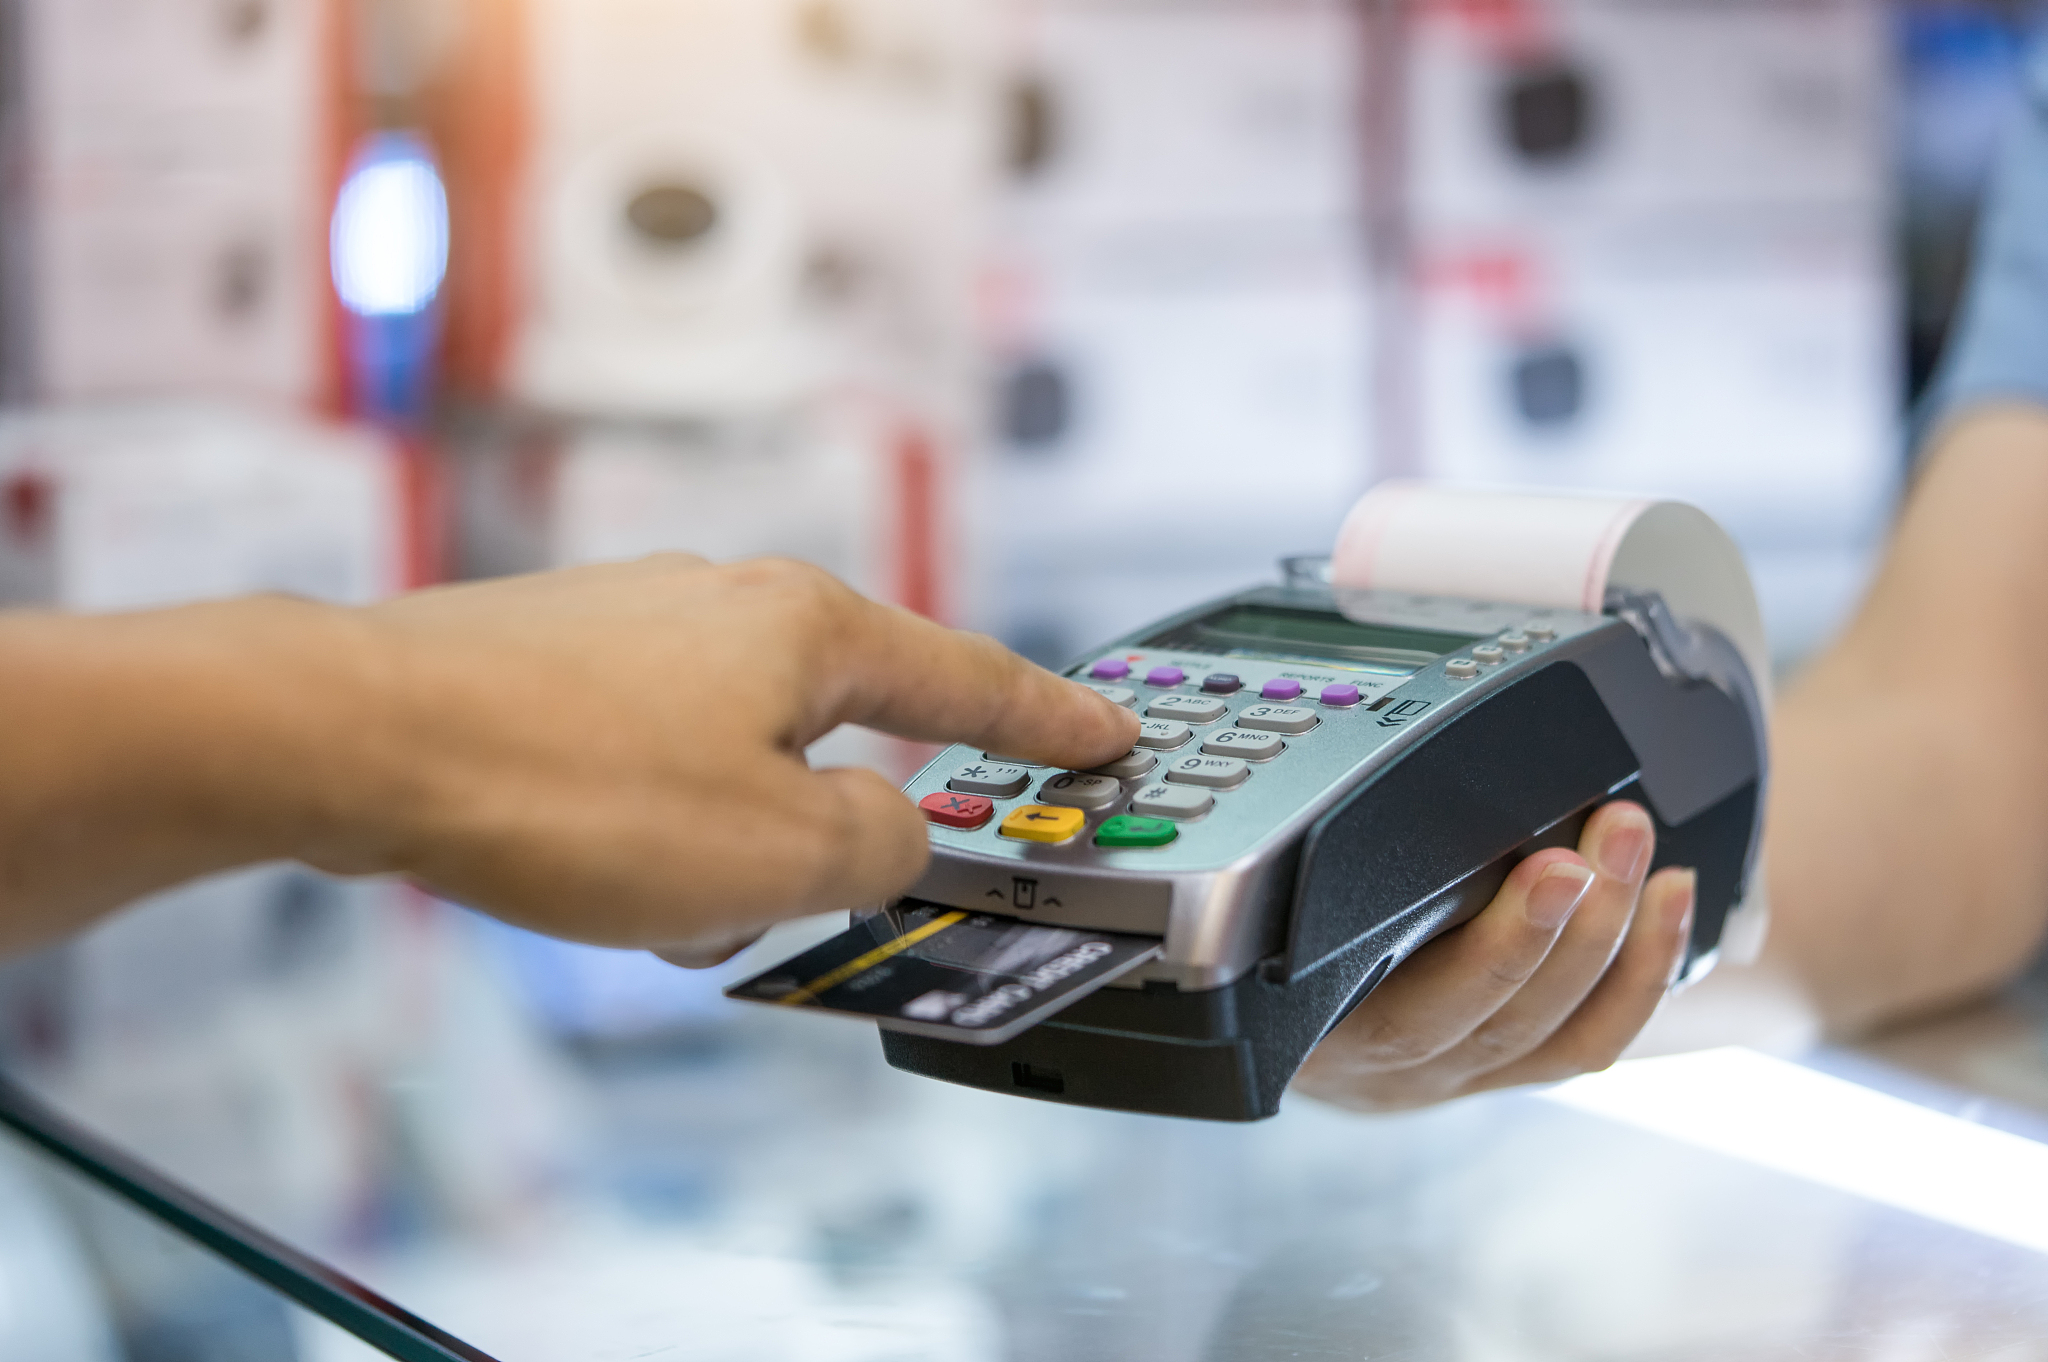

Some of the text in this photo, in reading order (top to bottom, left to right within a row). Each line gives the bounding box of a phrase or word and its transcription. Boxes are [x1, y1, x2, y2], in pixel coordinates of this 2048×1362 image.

[1279, 672, 1336, 683] REPORTS
[1348, 680, 1384, 689] FUNC
[1159, 697, 1212, 707] 2 ABC
[1249, 707, 1302, 717] 3 DEF
[1146, 722, 1170, 731] JKL
[1215, 731, 1270, 743] 6 MNO
[1180, 758, 1234, 770] 9 WXY
[1053, 777, 1075, 789] 0
[1018, 941, 1114, 992] CREDIT
